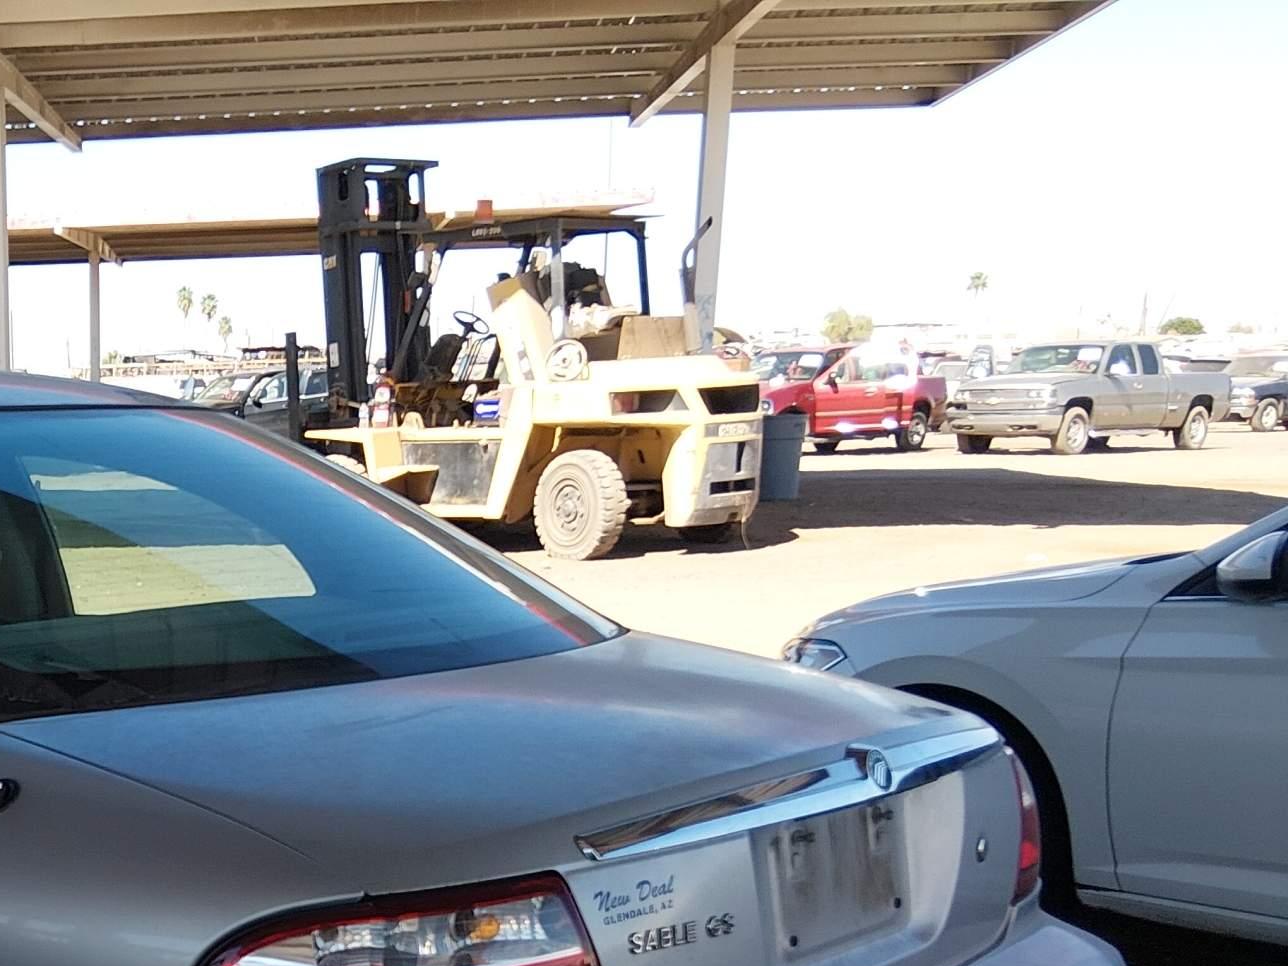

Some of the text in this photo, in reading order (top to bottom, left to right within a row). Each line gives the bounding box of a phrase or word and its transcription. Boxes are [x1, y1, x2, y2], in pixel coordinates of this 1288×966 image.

[593, 874, 674, 912] New Deal
[603, 899, 674, 925] GLENDALE, AZ
[628, 912, 735, 955] SABLE GS
